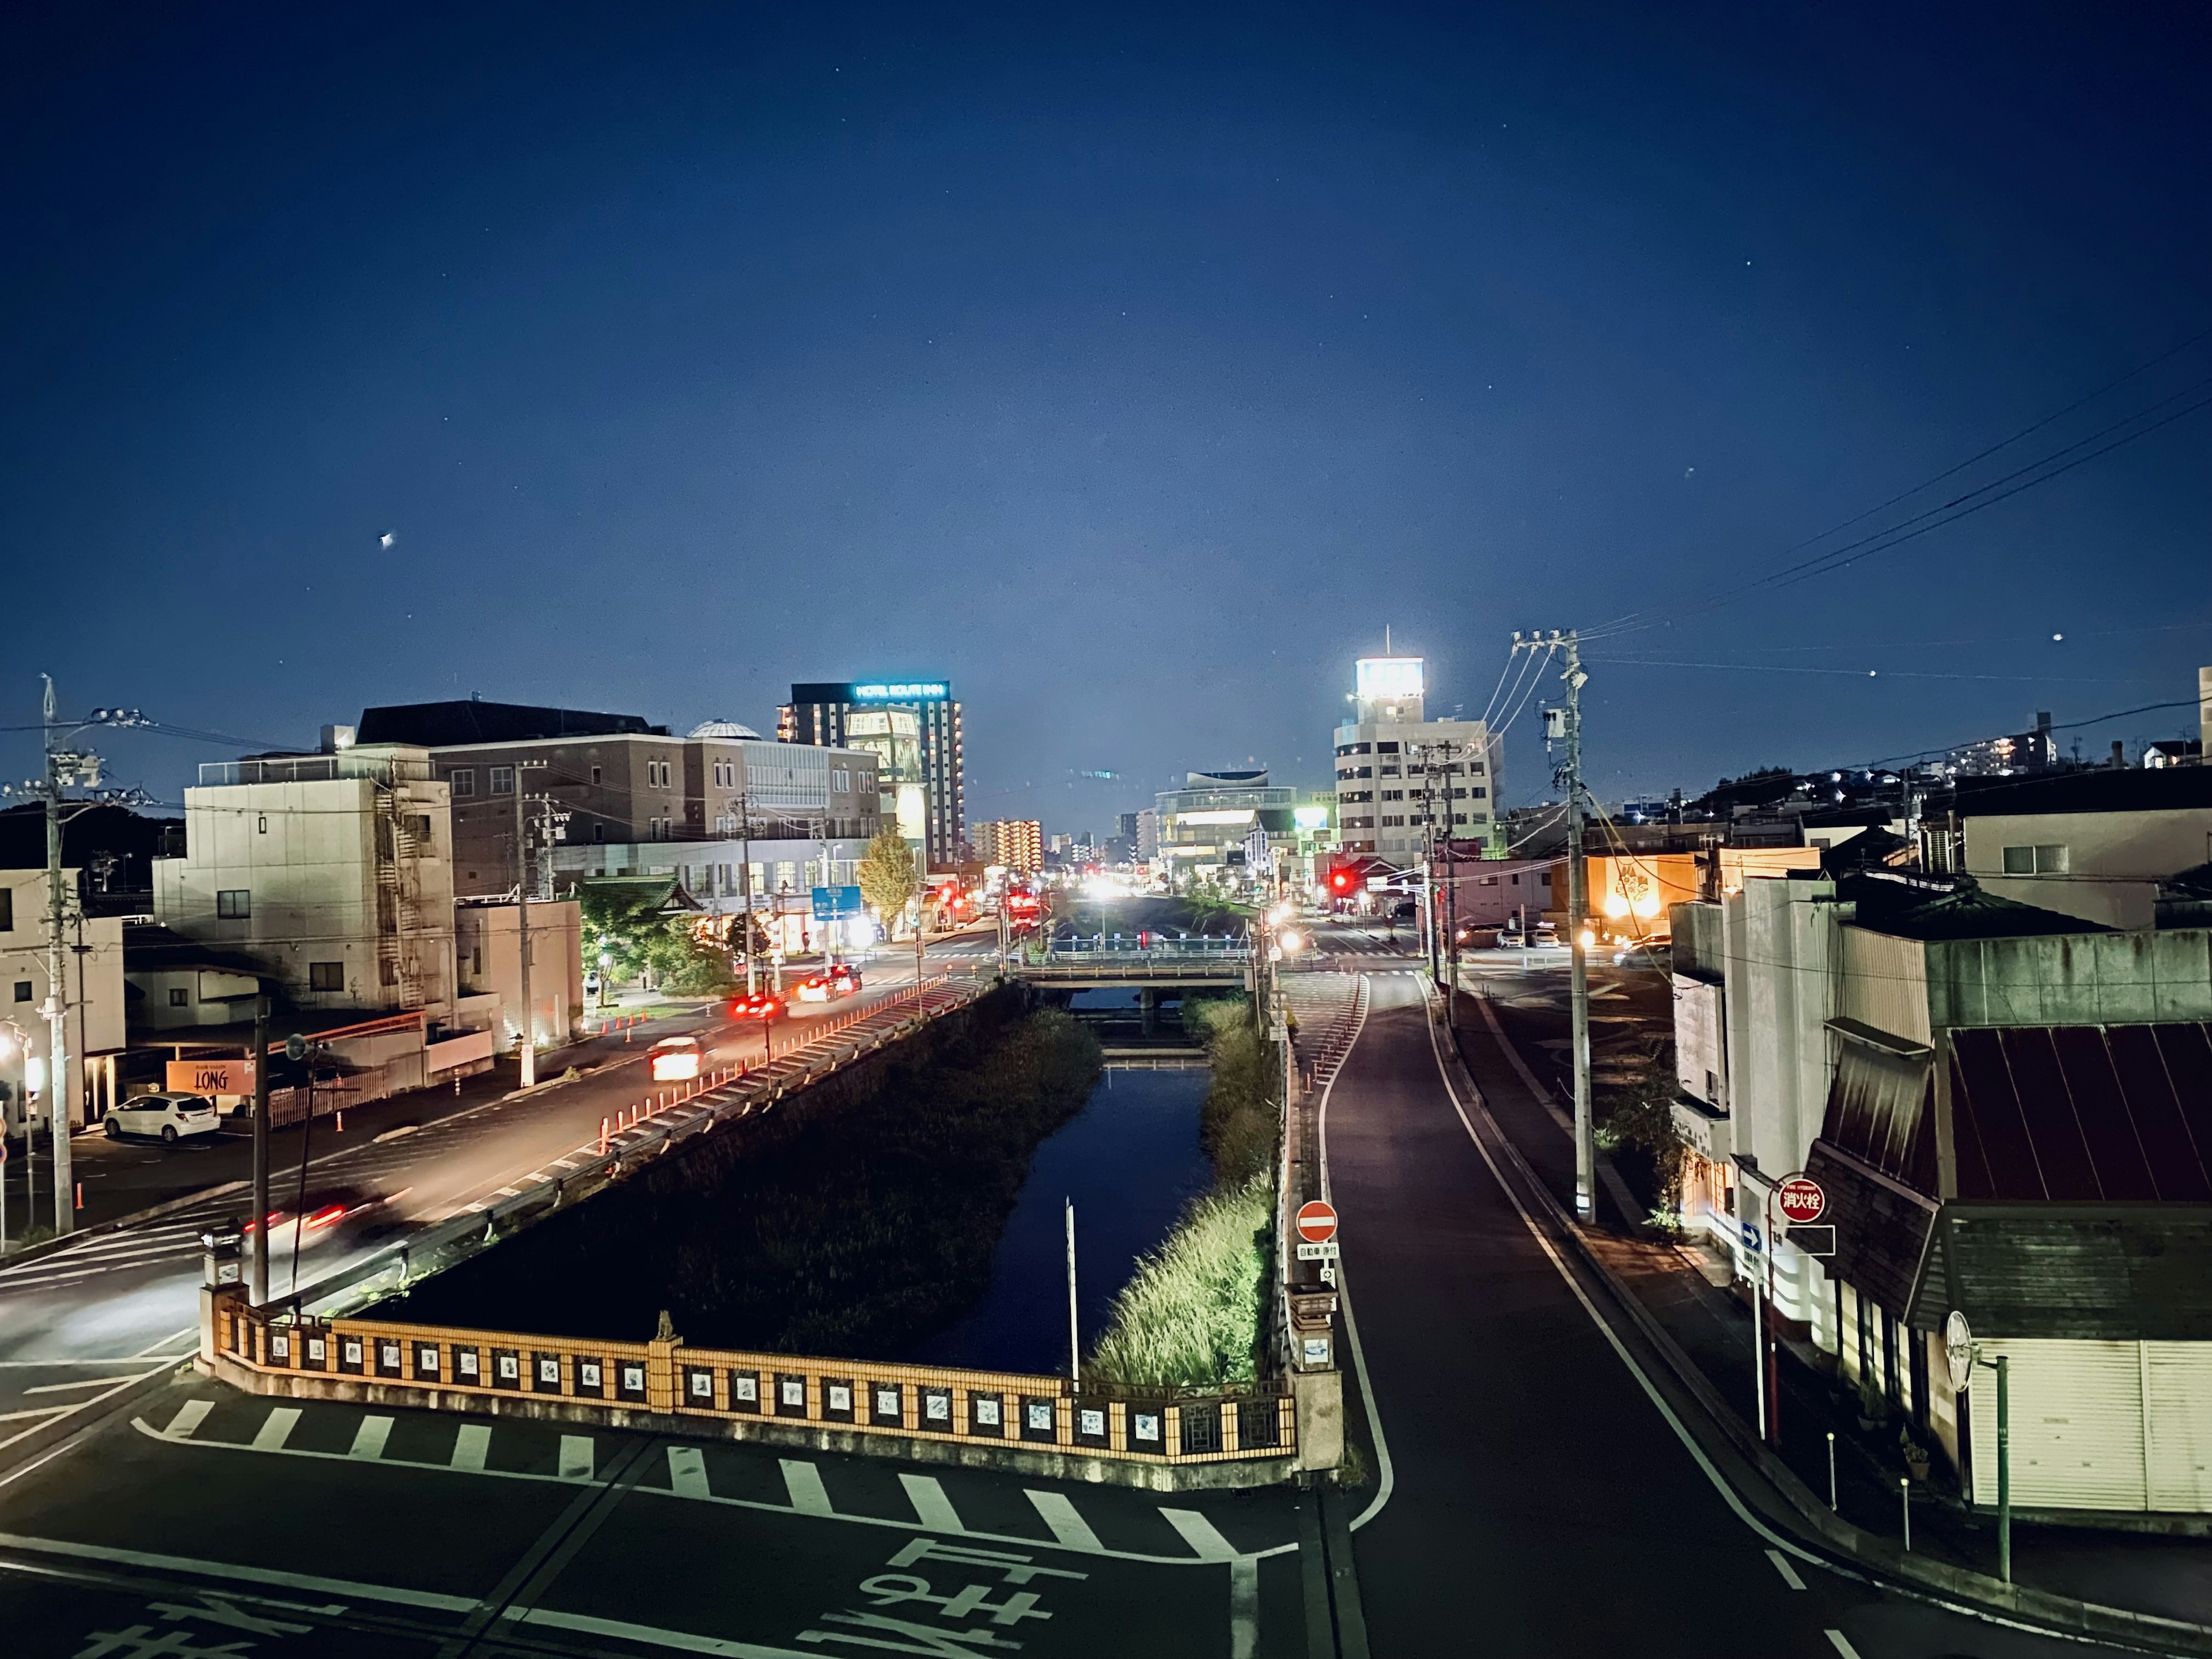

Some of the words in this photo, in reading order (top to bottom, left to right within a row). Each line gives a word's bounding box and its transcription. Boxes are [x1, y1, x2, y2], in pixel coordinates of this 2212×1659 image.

[856, 685, 889, 696] HOTEL
[889, 684, 922, 696] ROUTE
[923, 684, 944, 695] INN
[194, 1070, 229, 1090] LONG
[1783, 1192, 1820, 1210] 消火栓
